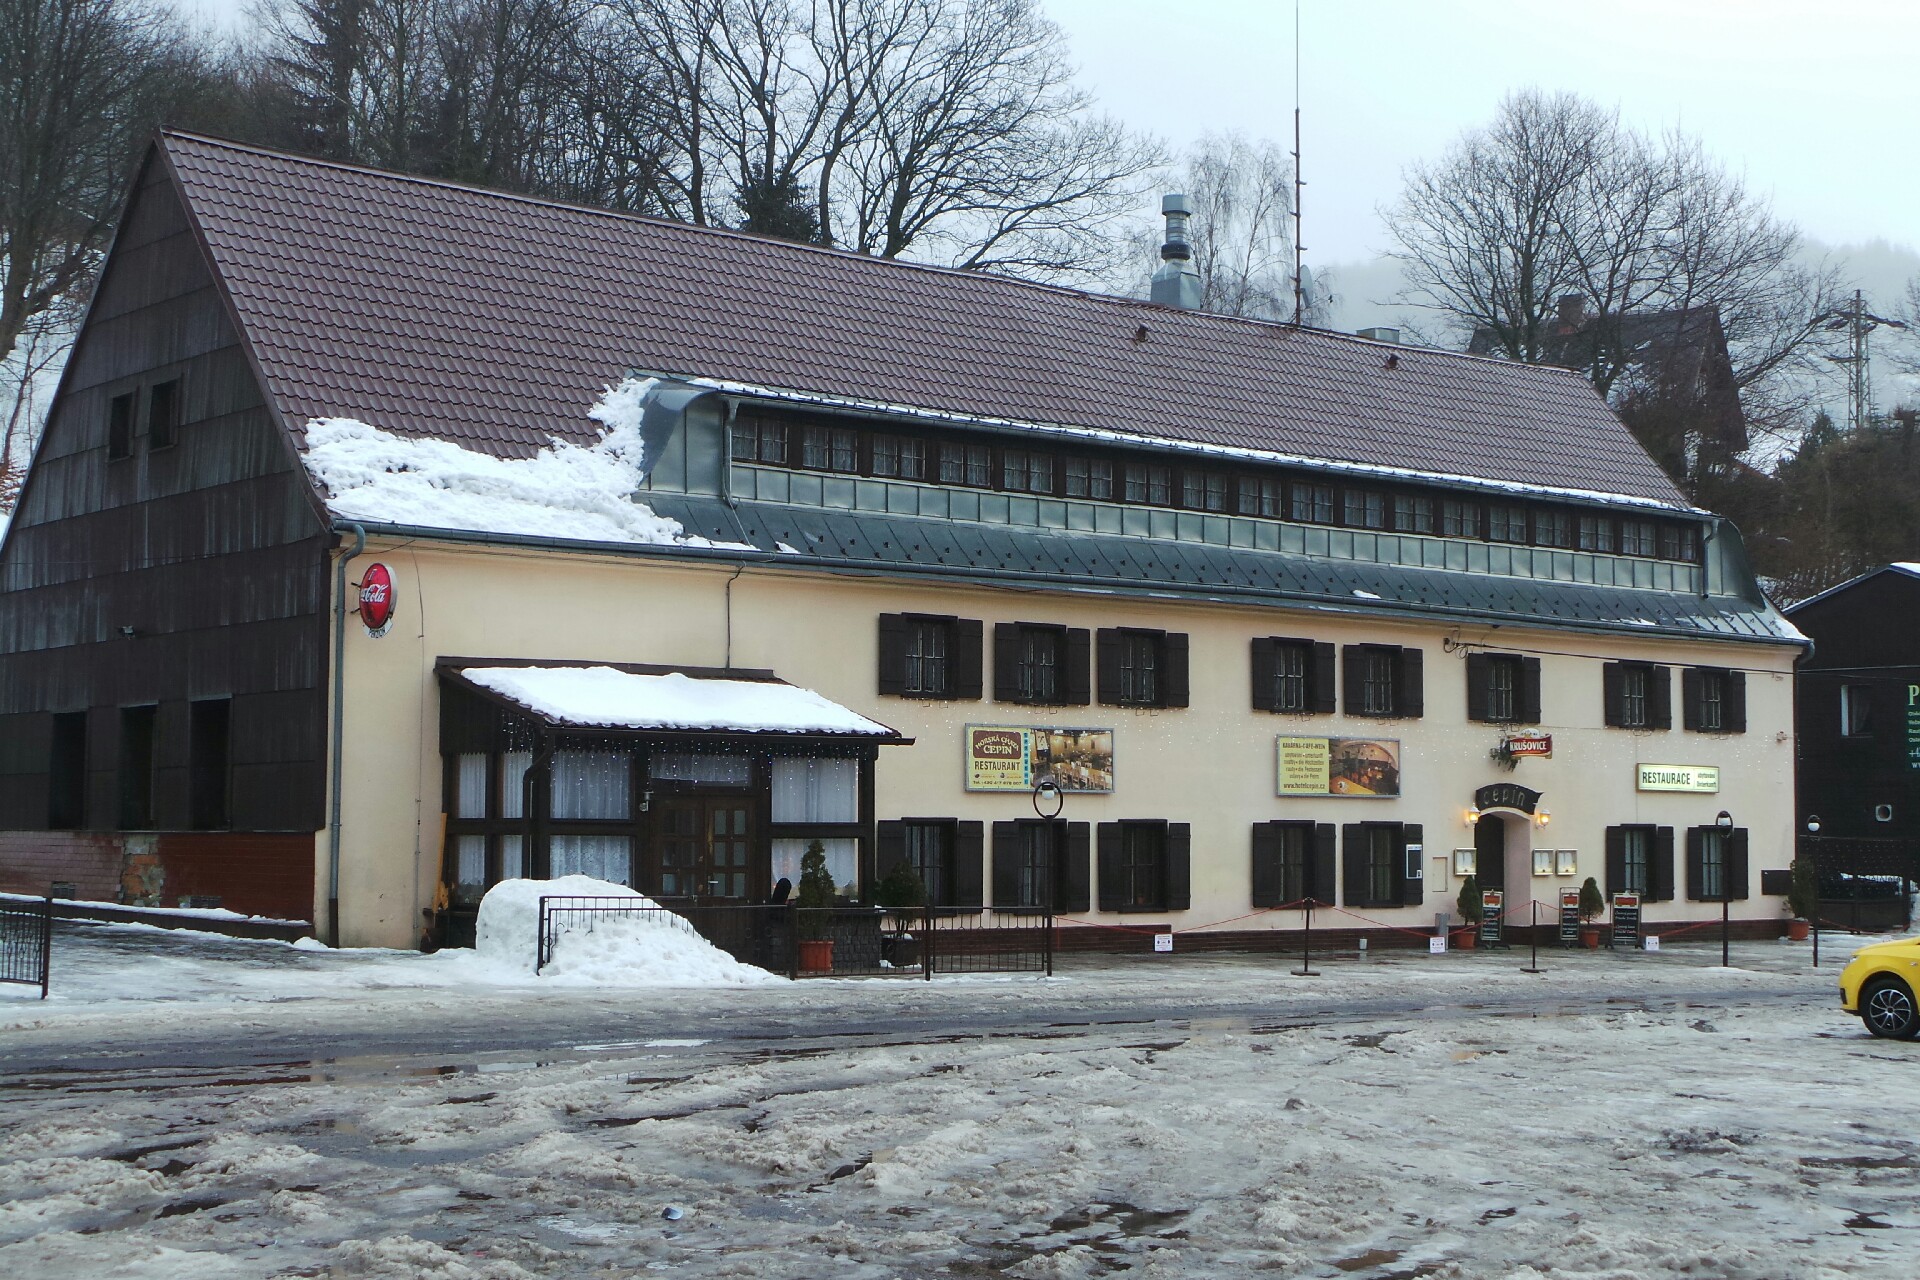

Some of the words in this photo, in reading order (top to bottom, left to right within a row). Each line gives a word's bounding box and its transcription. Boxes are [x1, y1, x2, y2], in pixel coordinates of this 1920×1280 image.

[1509, 739, 1547, 752] KRUŠOVICE
[974, 760, 1021, 771] RESTAURANT
[1642, 771, 1691, 785] RESTAURACE
